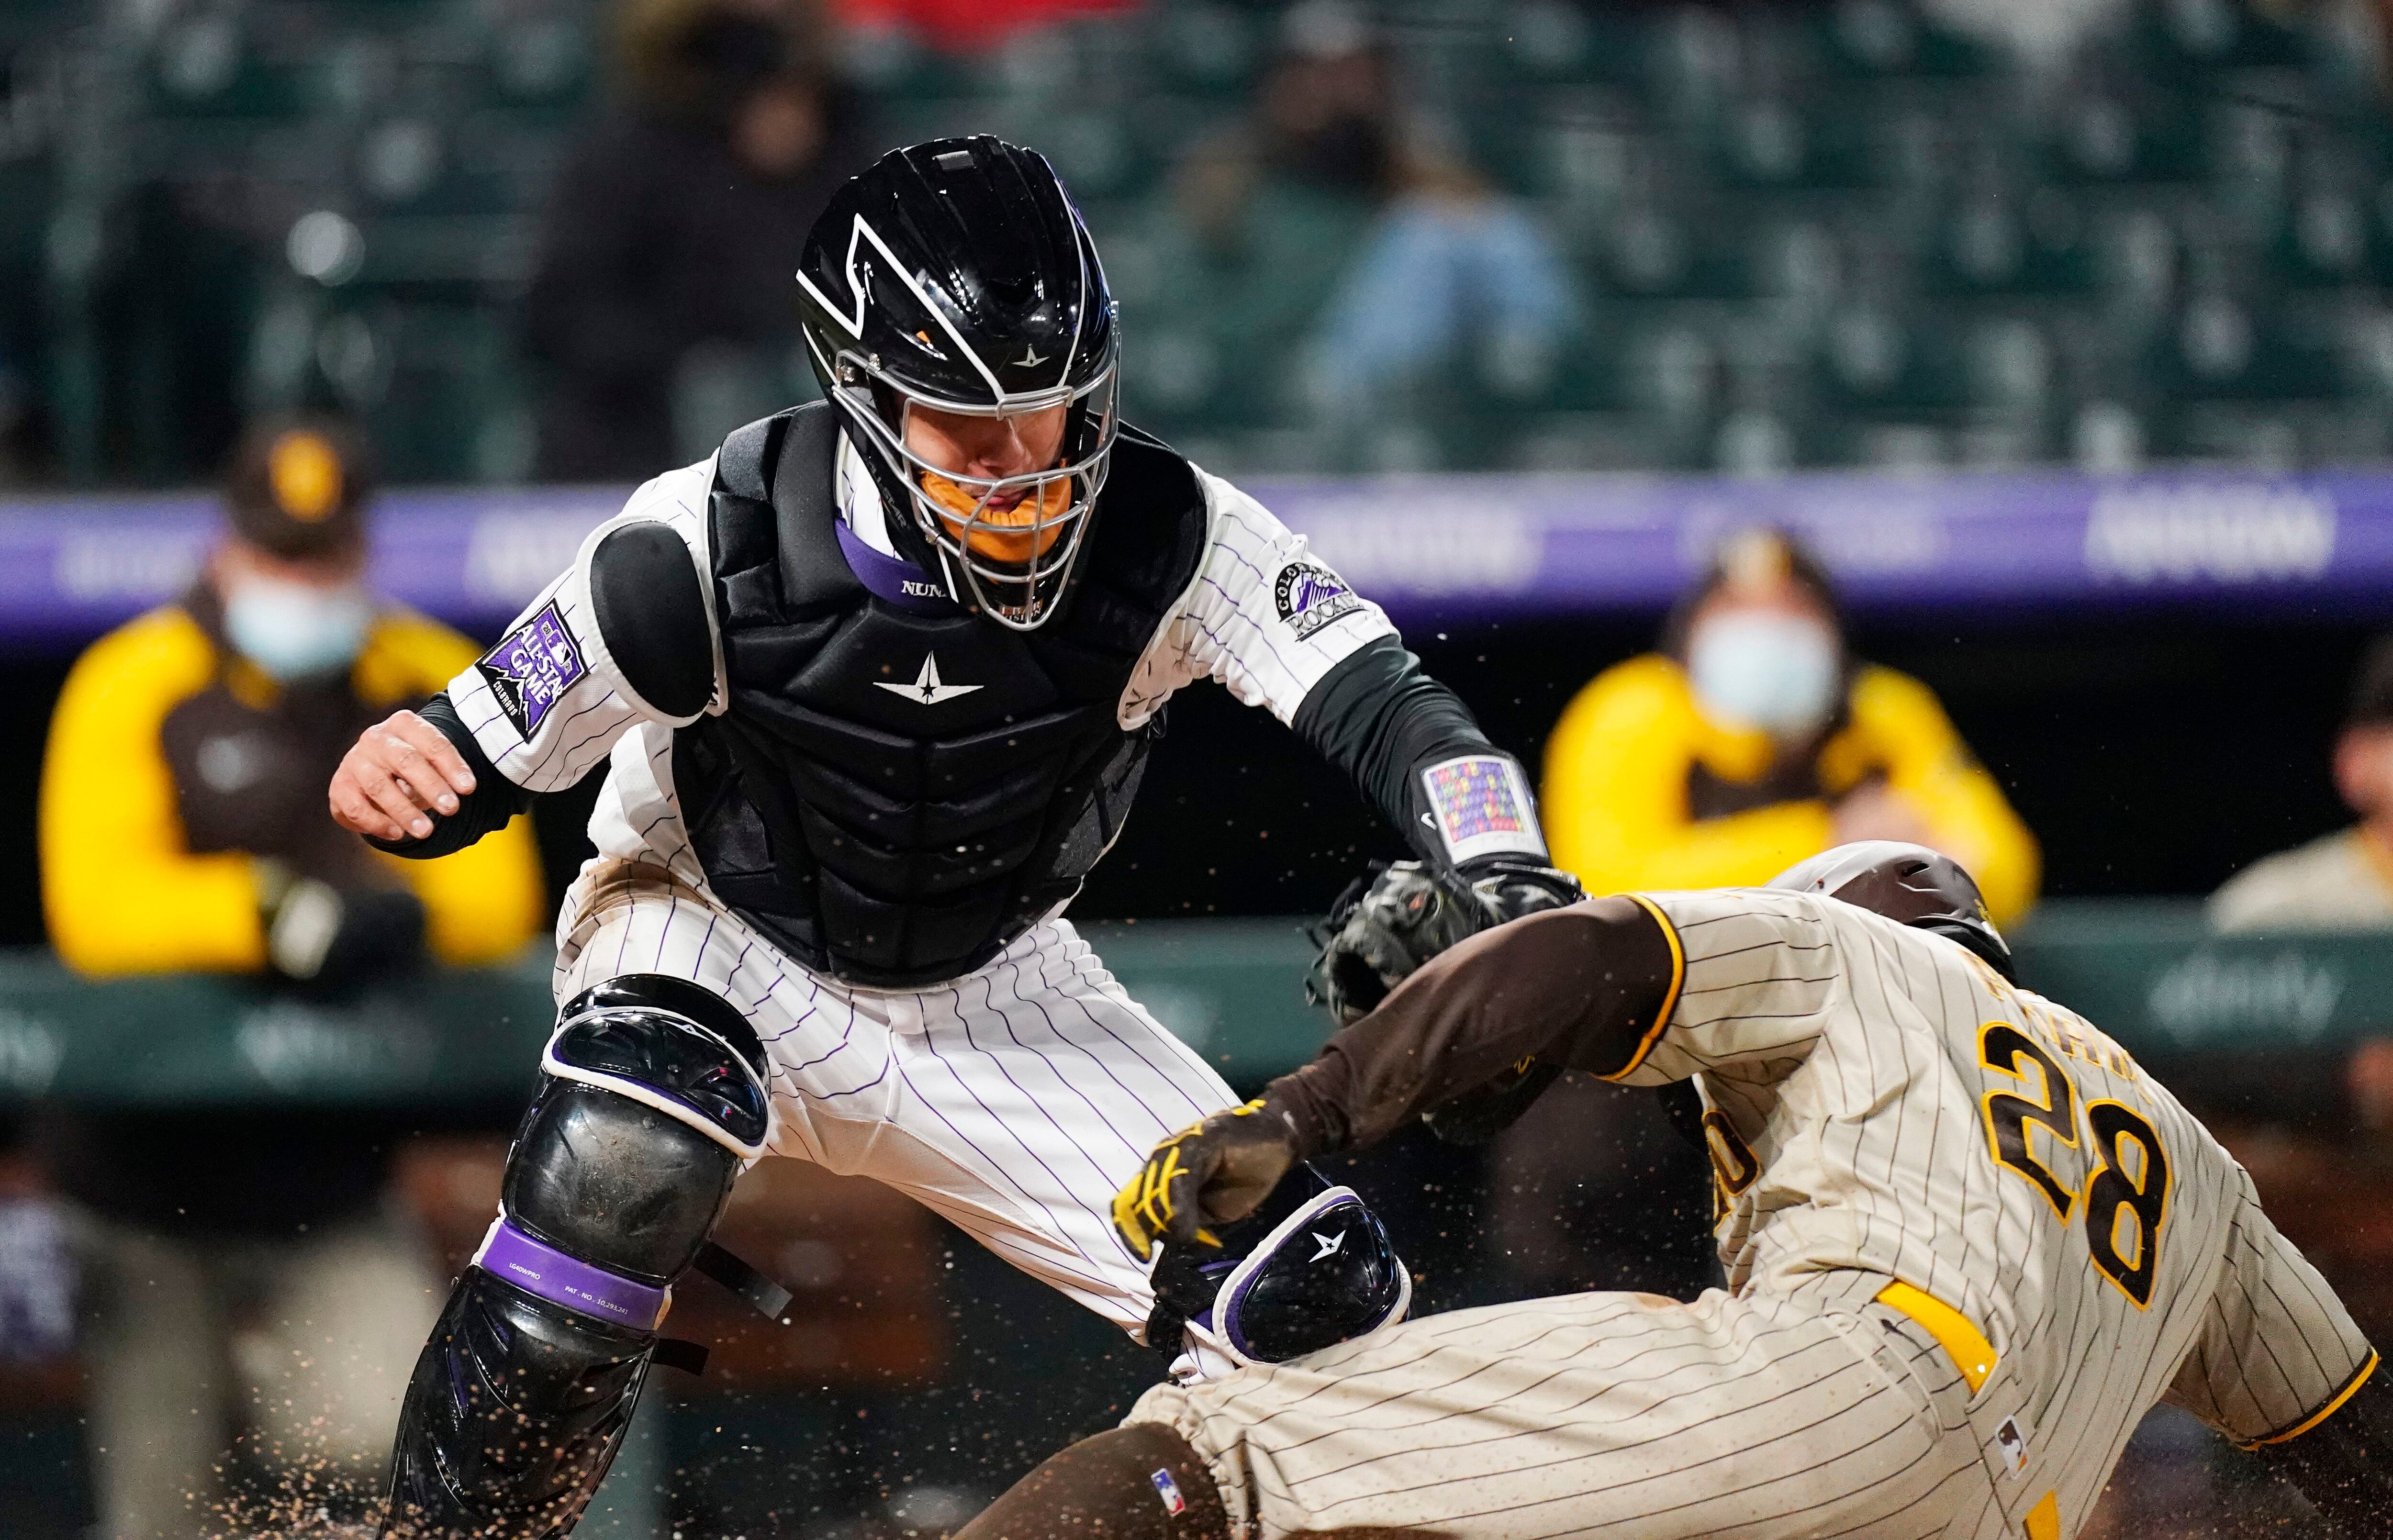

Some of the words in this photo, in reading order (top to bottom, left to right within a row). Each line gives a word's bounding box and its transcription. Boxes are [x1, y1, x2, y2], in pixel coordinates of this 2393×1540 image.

[901, 580, 947, 598] NUN
[1277, 563, 1342, 611] COLOR
[1286, 592, 1362, 637] ROCK
[511, 649, 551, 705] GAME
[493, 681, 518, 716] COLORADO
[1977, 1020, 2172, 1312] 28
[509, 1262, 541, 1280] LG40WPRO
[597, 1298, 628, 1315] 10,293,241
